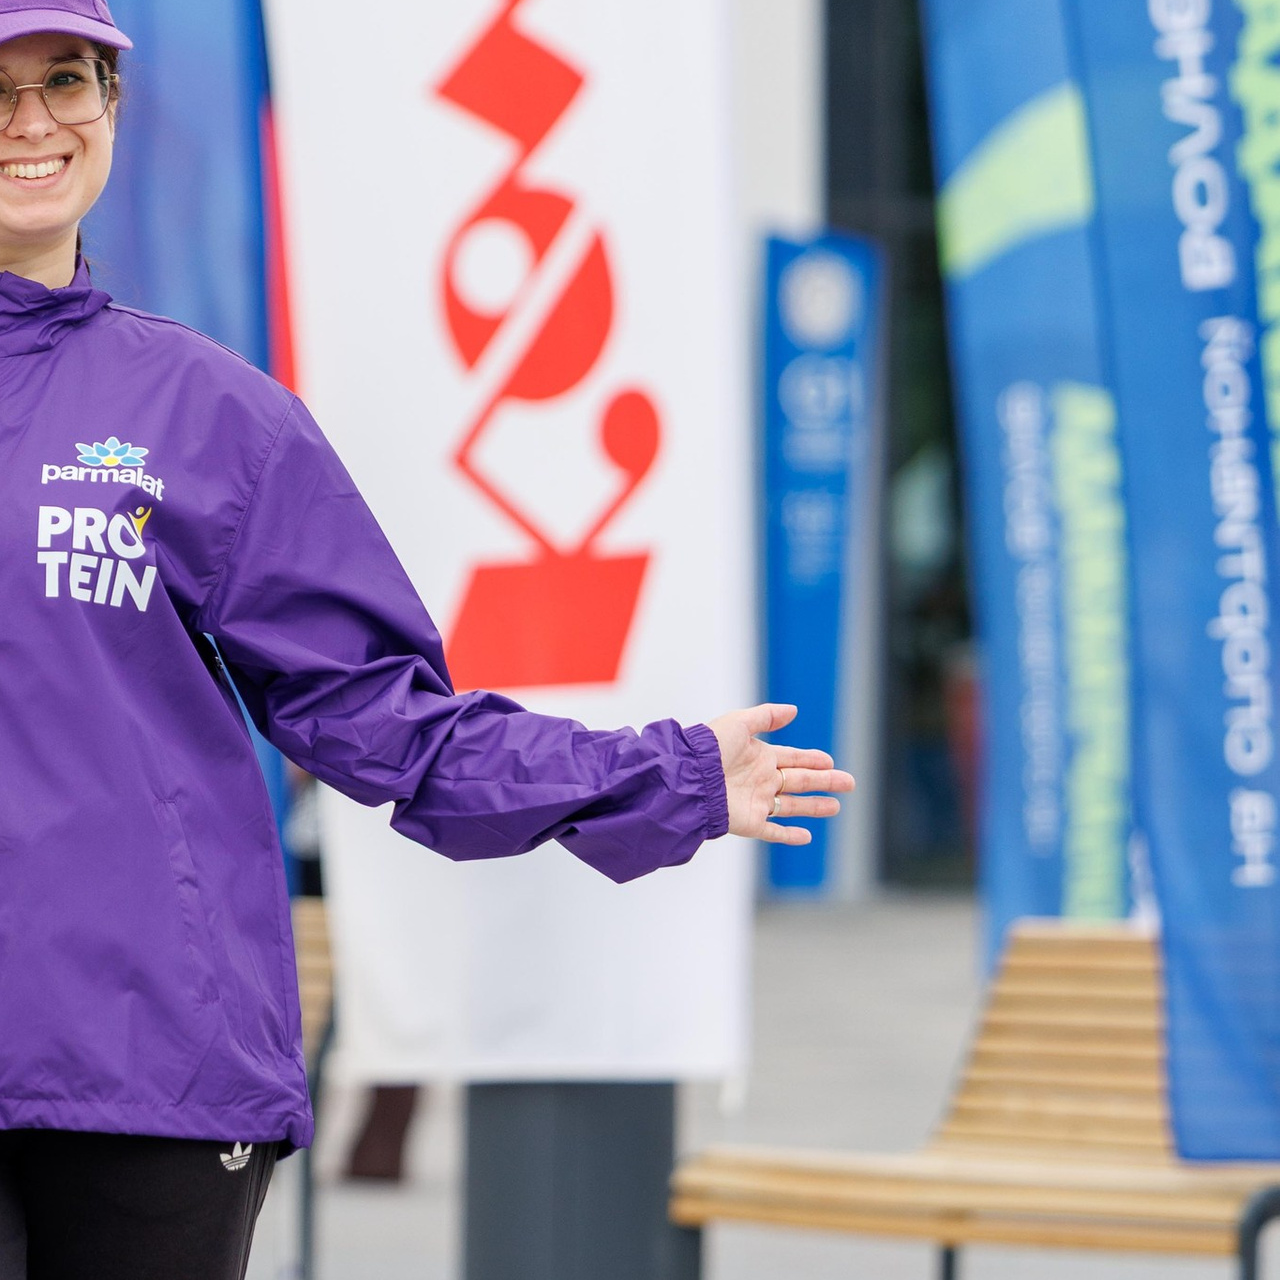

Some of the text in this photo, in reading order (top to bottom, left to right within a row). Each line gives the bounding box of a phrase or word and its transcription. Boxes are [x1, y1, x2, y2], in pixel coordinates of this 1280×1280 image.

[40, 463, 165, 501] parmalat
[37, 505, 150, 560] PRO
[36, 550, 158, 612] TEIN
